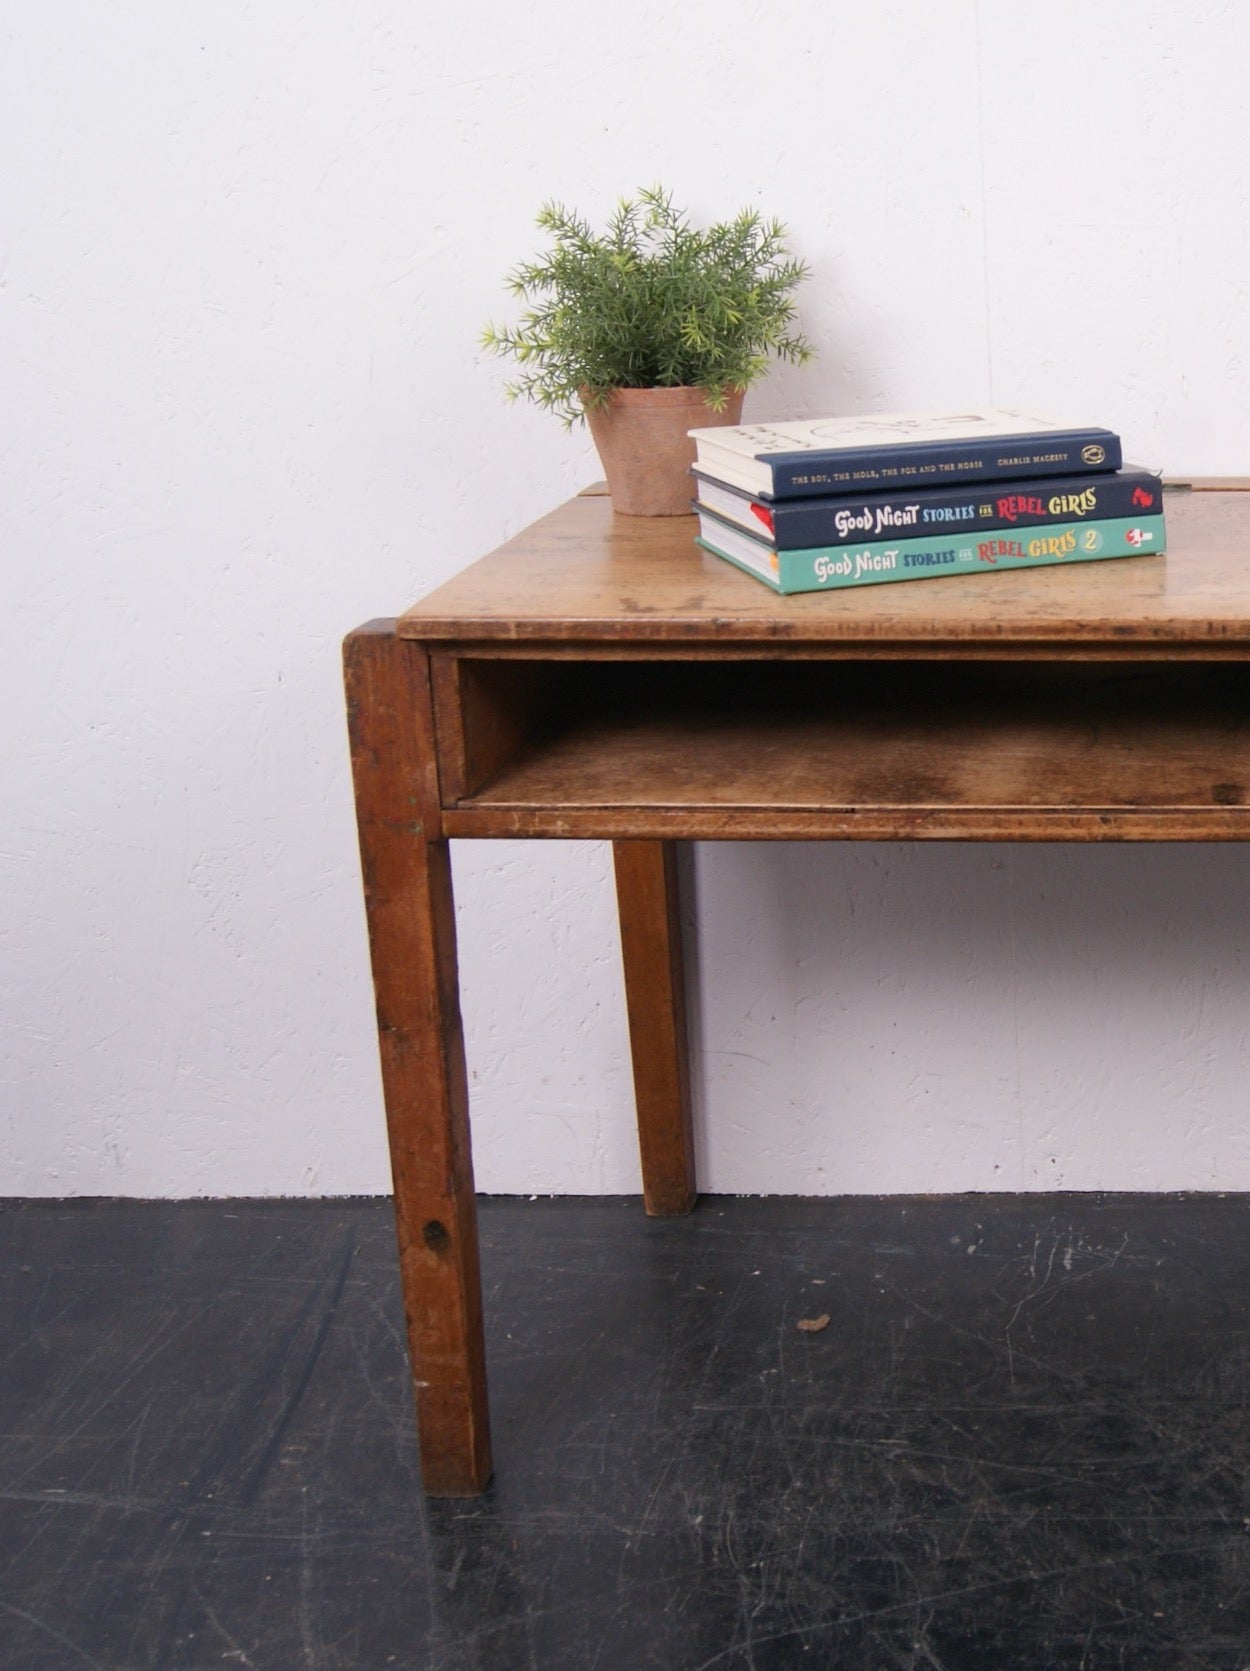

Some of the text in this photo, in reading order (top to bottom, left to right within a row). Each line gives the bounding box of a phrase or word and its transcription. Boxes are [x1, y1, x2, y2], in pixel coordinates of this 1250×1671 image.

[997, 456, 1031, 466] CHARLIE
[791, 476, 808, 485] THE
[833, 472, 850, 481] THE
[881, 468, 898, 477] THE
[919, 464, 936, 473] AND
[939, 463, 955, 471] THE
[923, 505, 975, 522] STORIES
[979, 504, 993, 517] FOR
[996, 496, 1047, 521] REBEL
[903, 550, 955, 567] STORIES
[977, 539, 1026, 564] REBEL
[1084, 529, 1097, 551] 2
